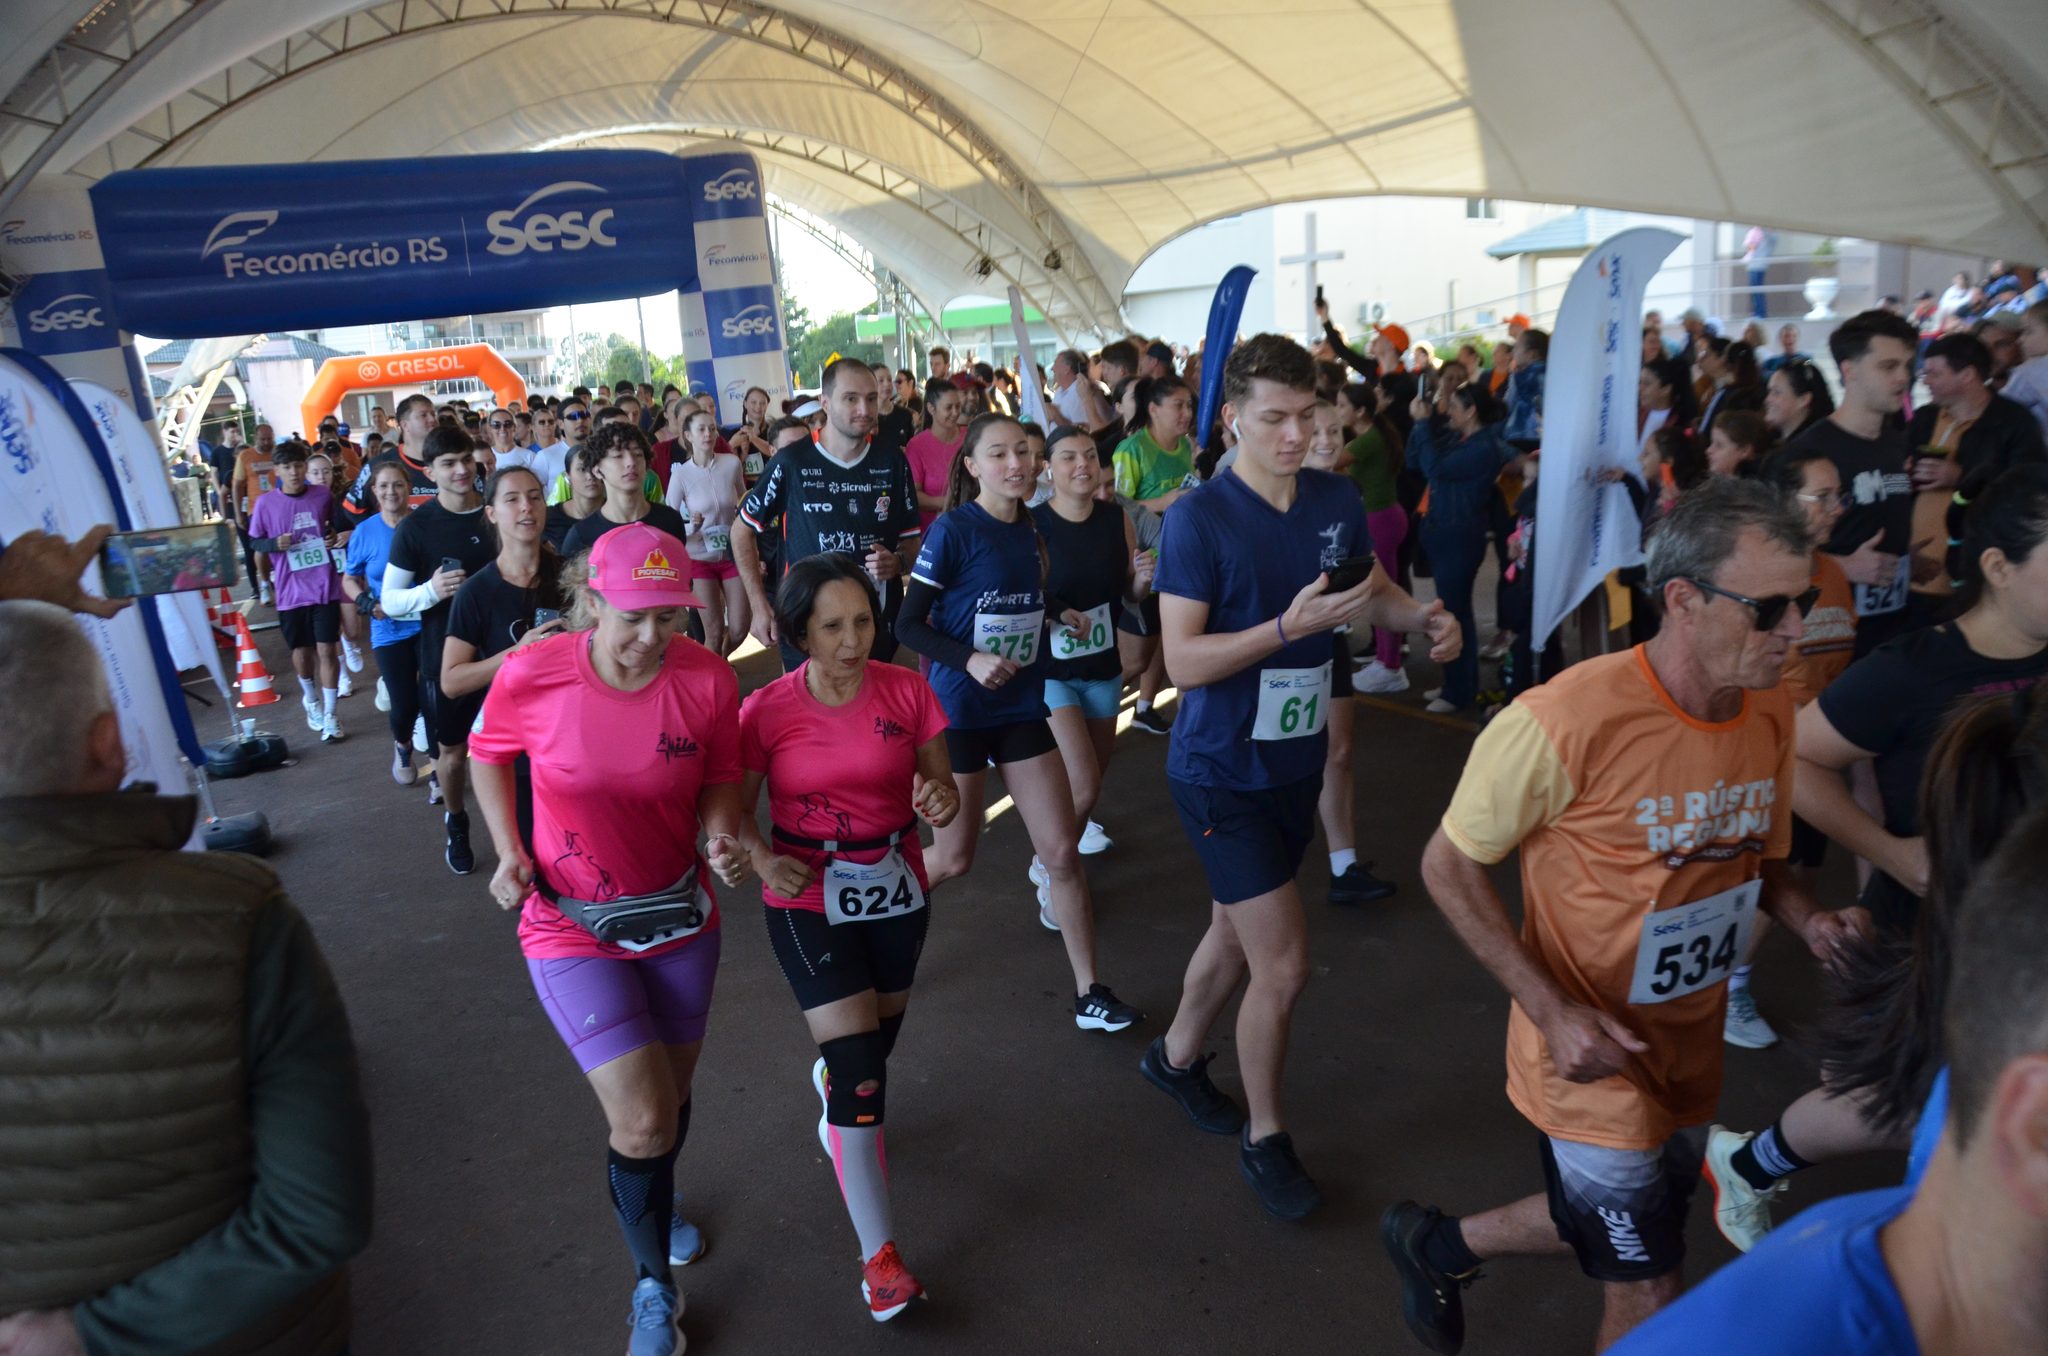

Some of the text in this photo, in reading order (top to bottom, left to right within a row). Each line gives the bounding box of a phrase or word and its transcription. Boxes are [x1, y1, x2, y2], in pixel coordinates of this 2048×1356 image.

[703, 181, 757, 202] Sesc
[6, 229, 94, 246] Fecomércio RS
[485, 208, 617, 256] Sesc
[222, 236, 449, 279] Fecomércio RS
[708, 252, 759, 267] Fecomércio
[28, 306, 105, 334] Sesc
[722, 315, 775, 338] Sesc
[386, 354, 465, 378] CRESOL
[841, 482, 872, 493] Sicredi
[802, 502, 833, 513] KTO
[294, 548, 324, 568] 169
[982, 623, 1008, 633] Sesc
[1268, 680, 1292, 689] Sesc
[1280, 692, 1319, 734] 61
[832, 870, 858, 881] Sesc
[838, 874, 914, 917] 624
[1649, 921, 1738, 996] 534
[1599, 1206, 1651, 1262] NIKE
